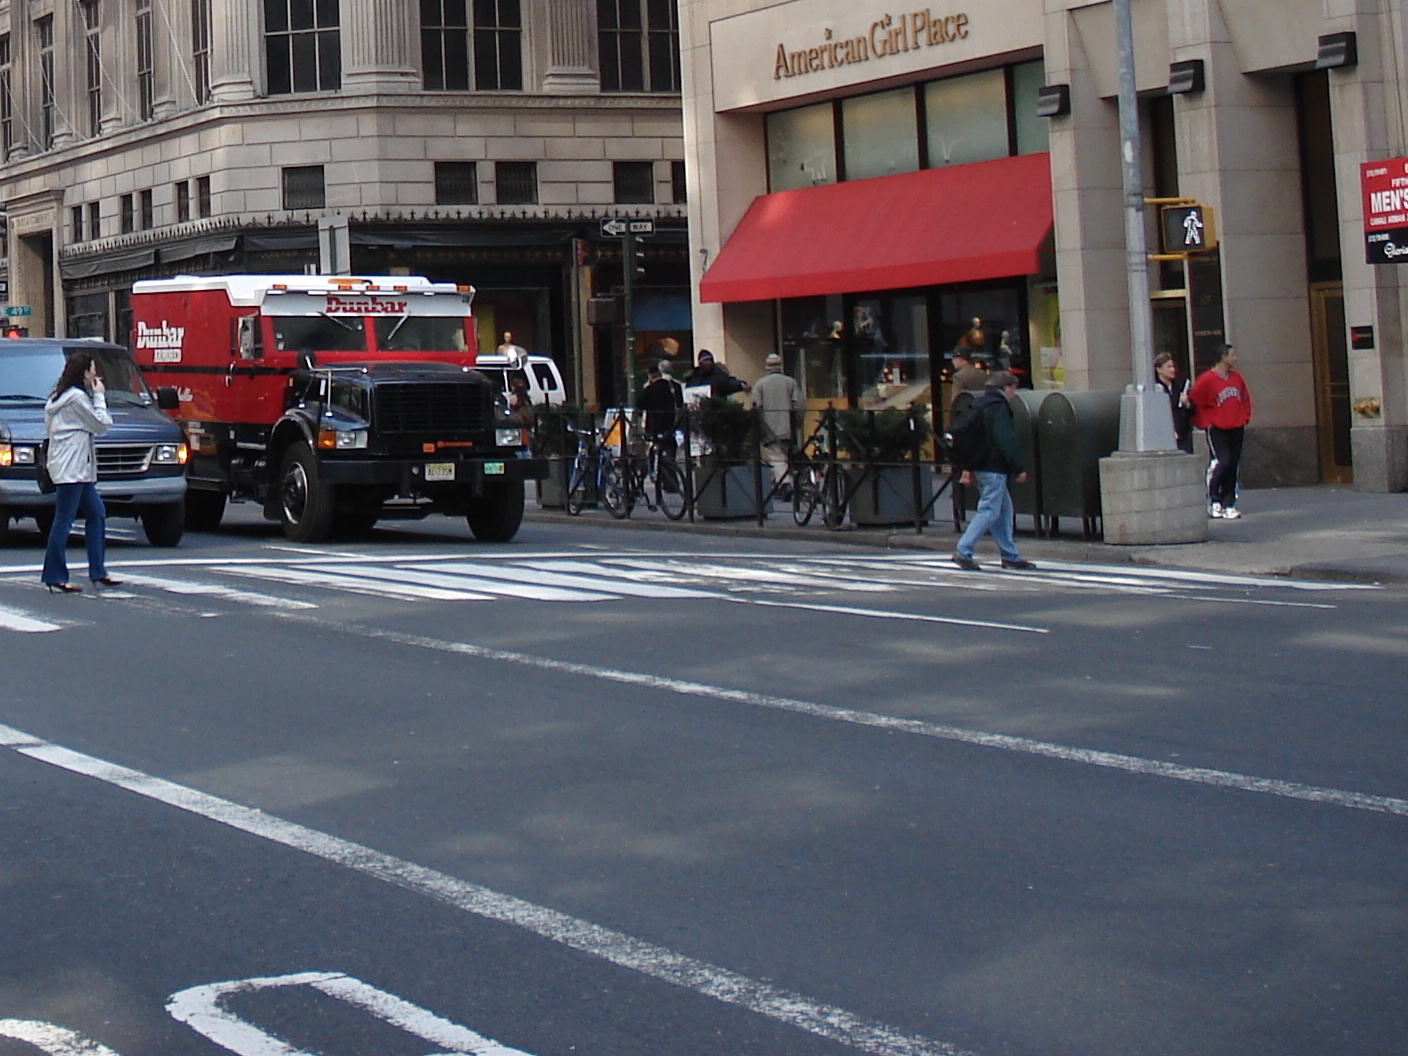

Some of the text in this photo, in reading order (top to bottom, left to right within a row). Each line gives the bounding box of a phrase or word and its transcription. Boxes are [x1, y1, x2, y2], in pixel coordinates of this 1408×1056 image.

[773, 8, 969, 80] American Girl Place
[608, 224, 622, 232] ONE
[326, 296, 407, 313] Dunbar
[137, 320, 184, 349] Dunbar
